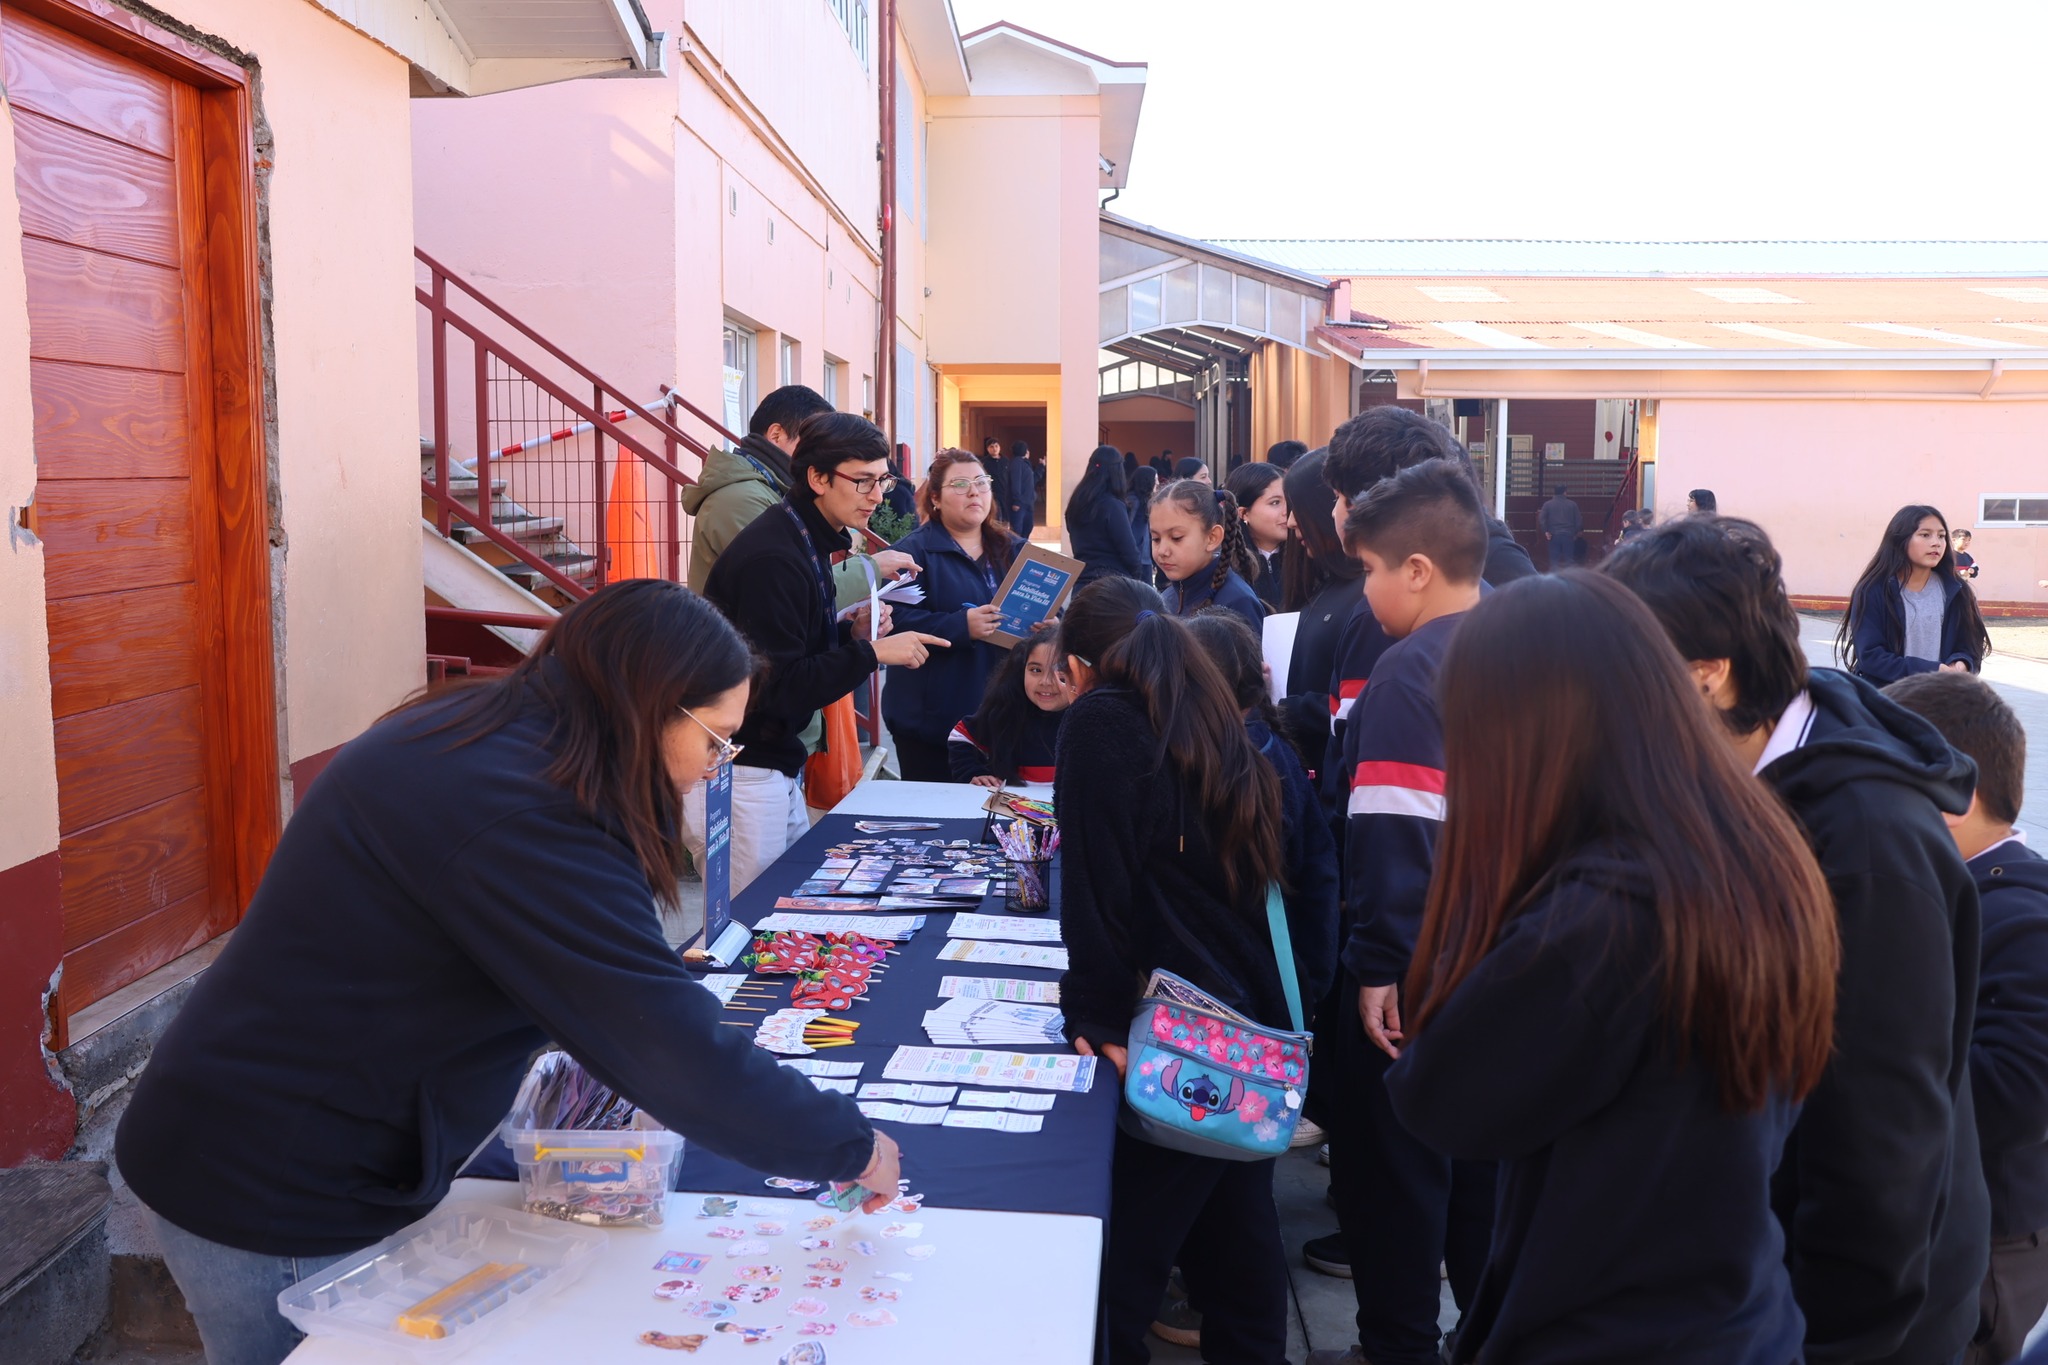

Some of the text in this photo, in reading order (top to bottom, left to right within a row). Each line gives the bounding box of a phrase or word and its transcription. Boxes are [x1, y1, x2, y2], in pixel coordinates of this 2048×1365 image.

[1022, 579, 1041, 588] Programa
[1011, 589, 1025, 597] para
[1030, 595, 1043, 603] Vida
[1018, 584, 1050, 599] Habilidades
[709, 816, 729, 840] Habilidades
